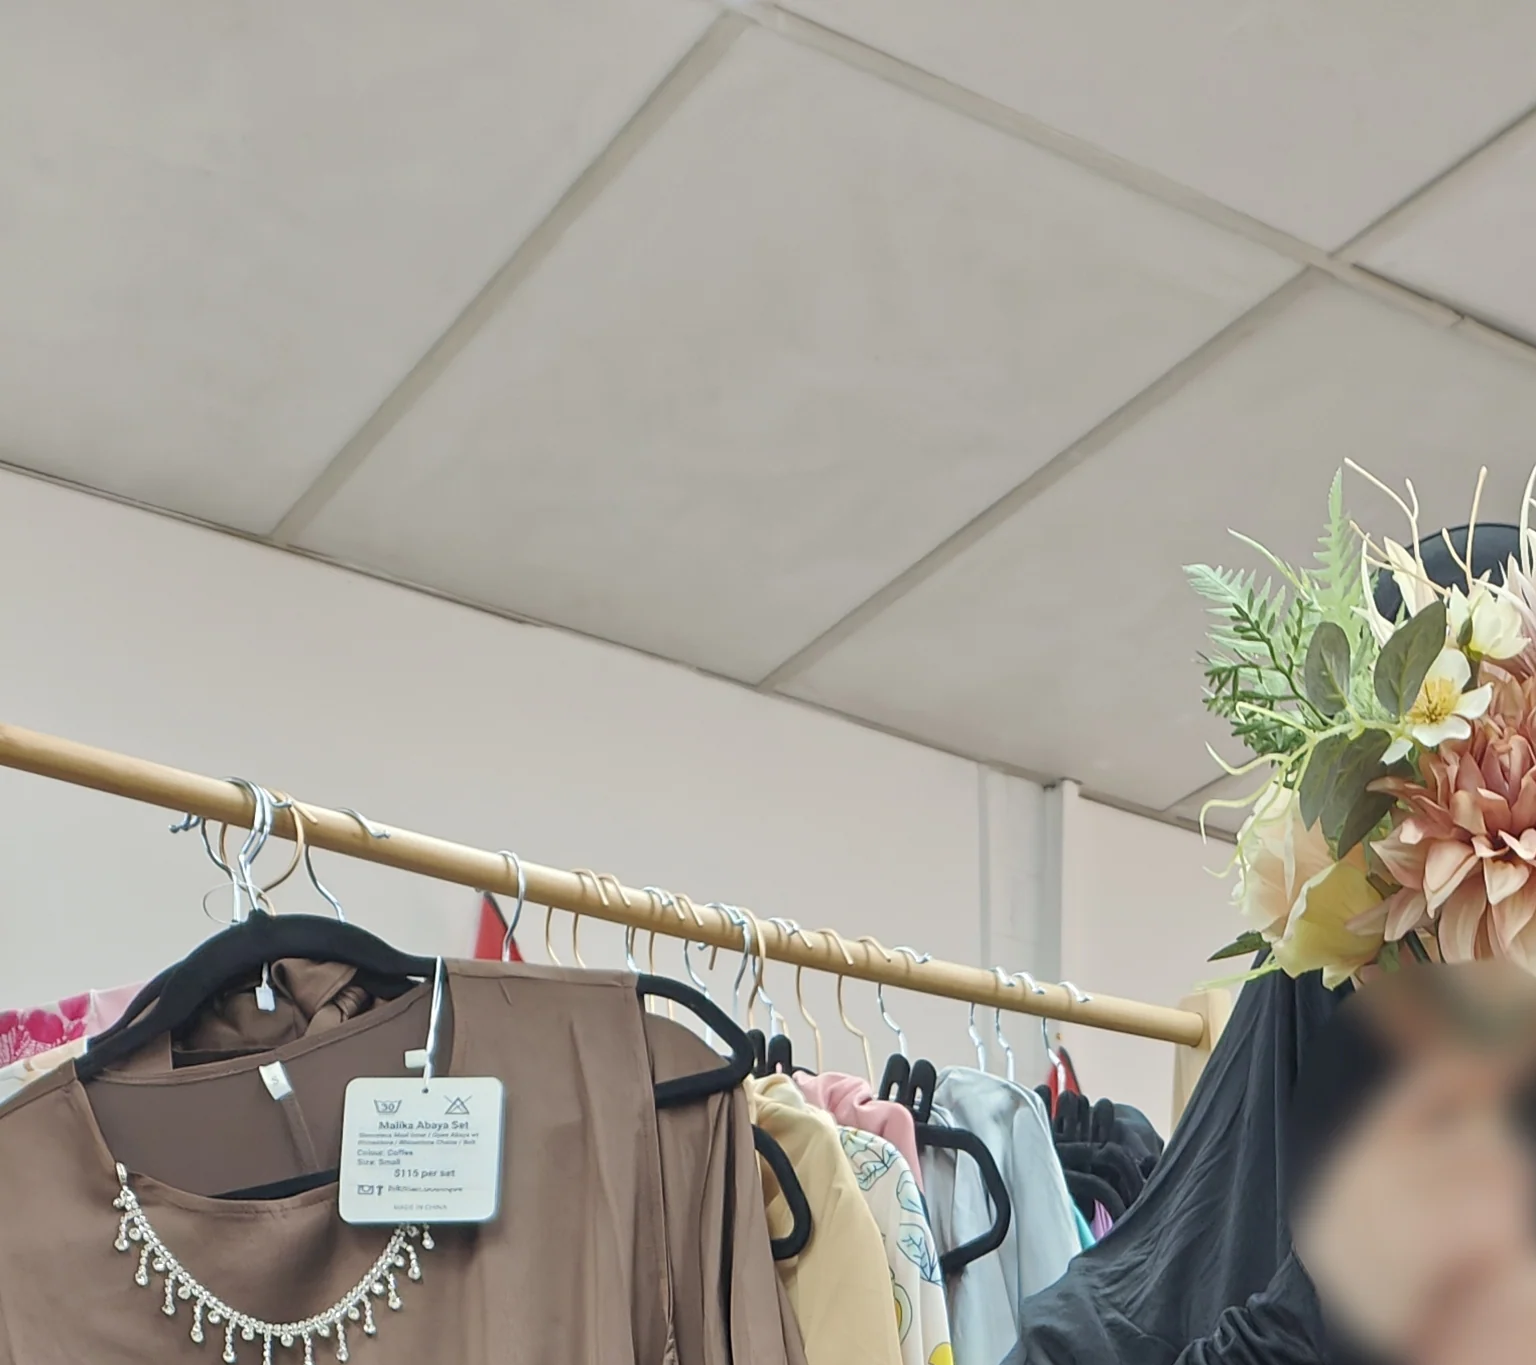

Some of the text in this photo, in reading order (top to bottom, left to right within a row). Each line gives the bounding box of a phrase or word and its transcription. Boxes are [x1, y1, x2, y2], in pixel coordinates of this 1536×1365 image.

[378, 1120, 469, 1131] Malika Abaya Set
[421, 1170, 437, 1178] per
